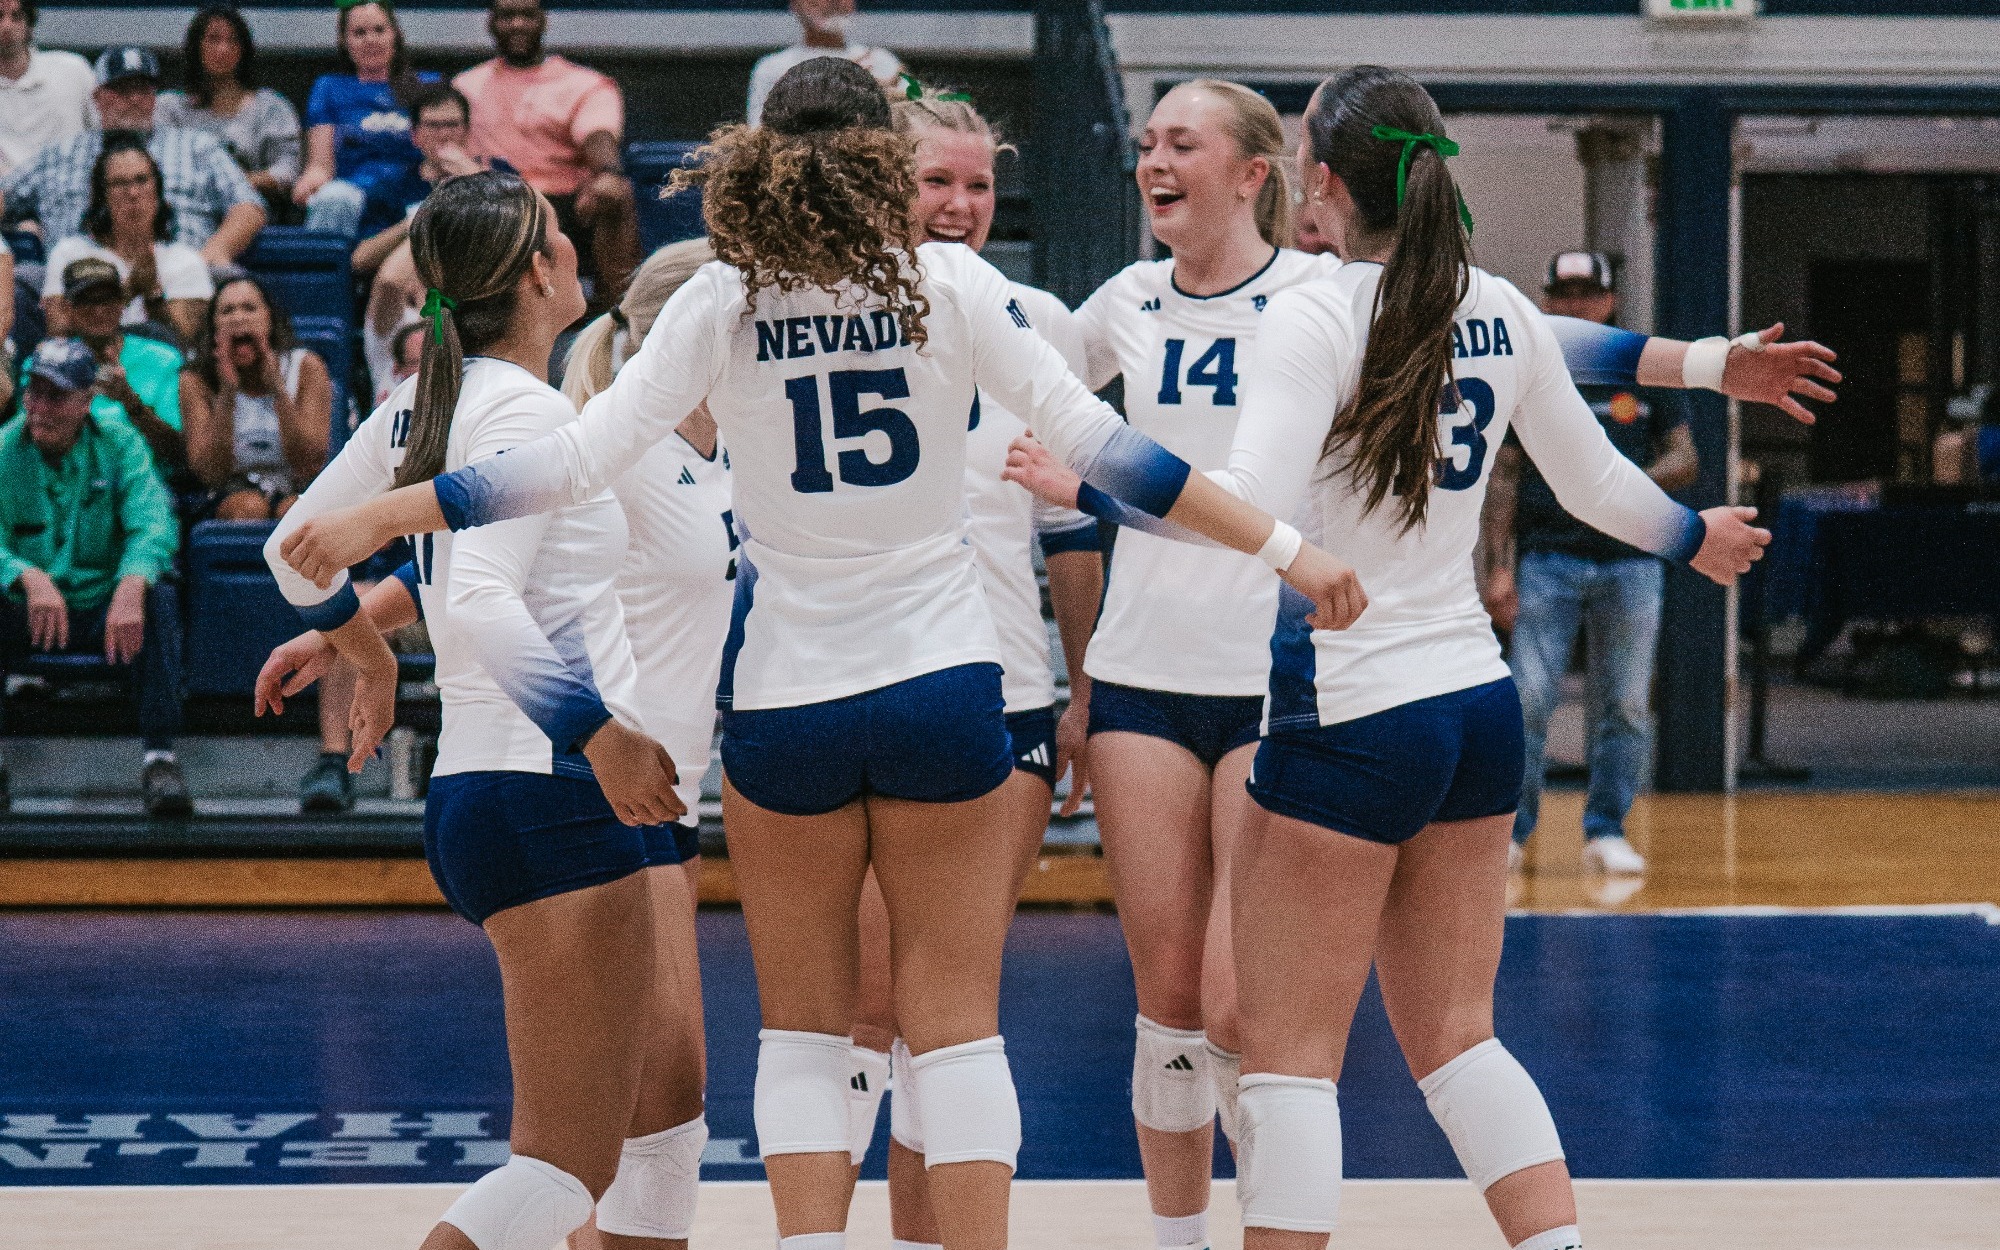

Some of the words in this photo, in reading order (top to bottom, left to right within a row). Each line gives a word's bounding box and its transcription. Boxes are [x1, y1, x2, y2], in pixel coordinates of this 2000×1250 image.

[1157, 337, 1239, 406] 14
[1451, 317, 1514, 359] ADA
[784, 366, 921, 494] 15
[1393, 376, 1496, 495] 3
